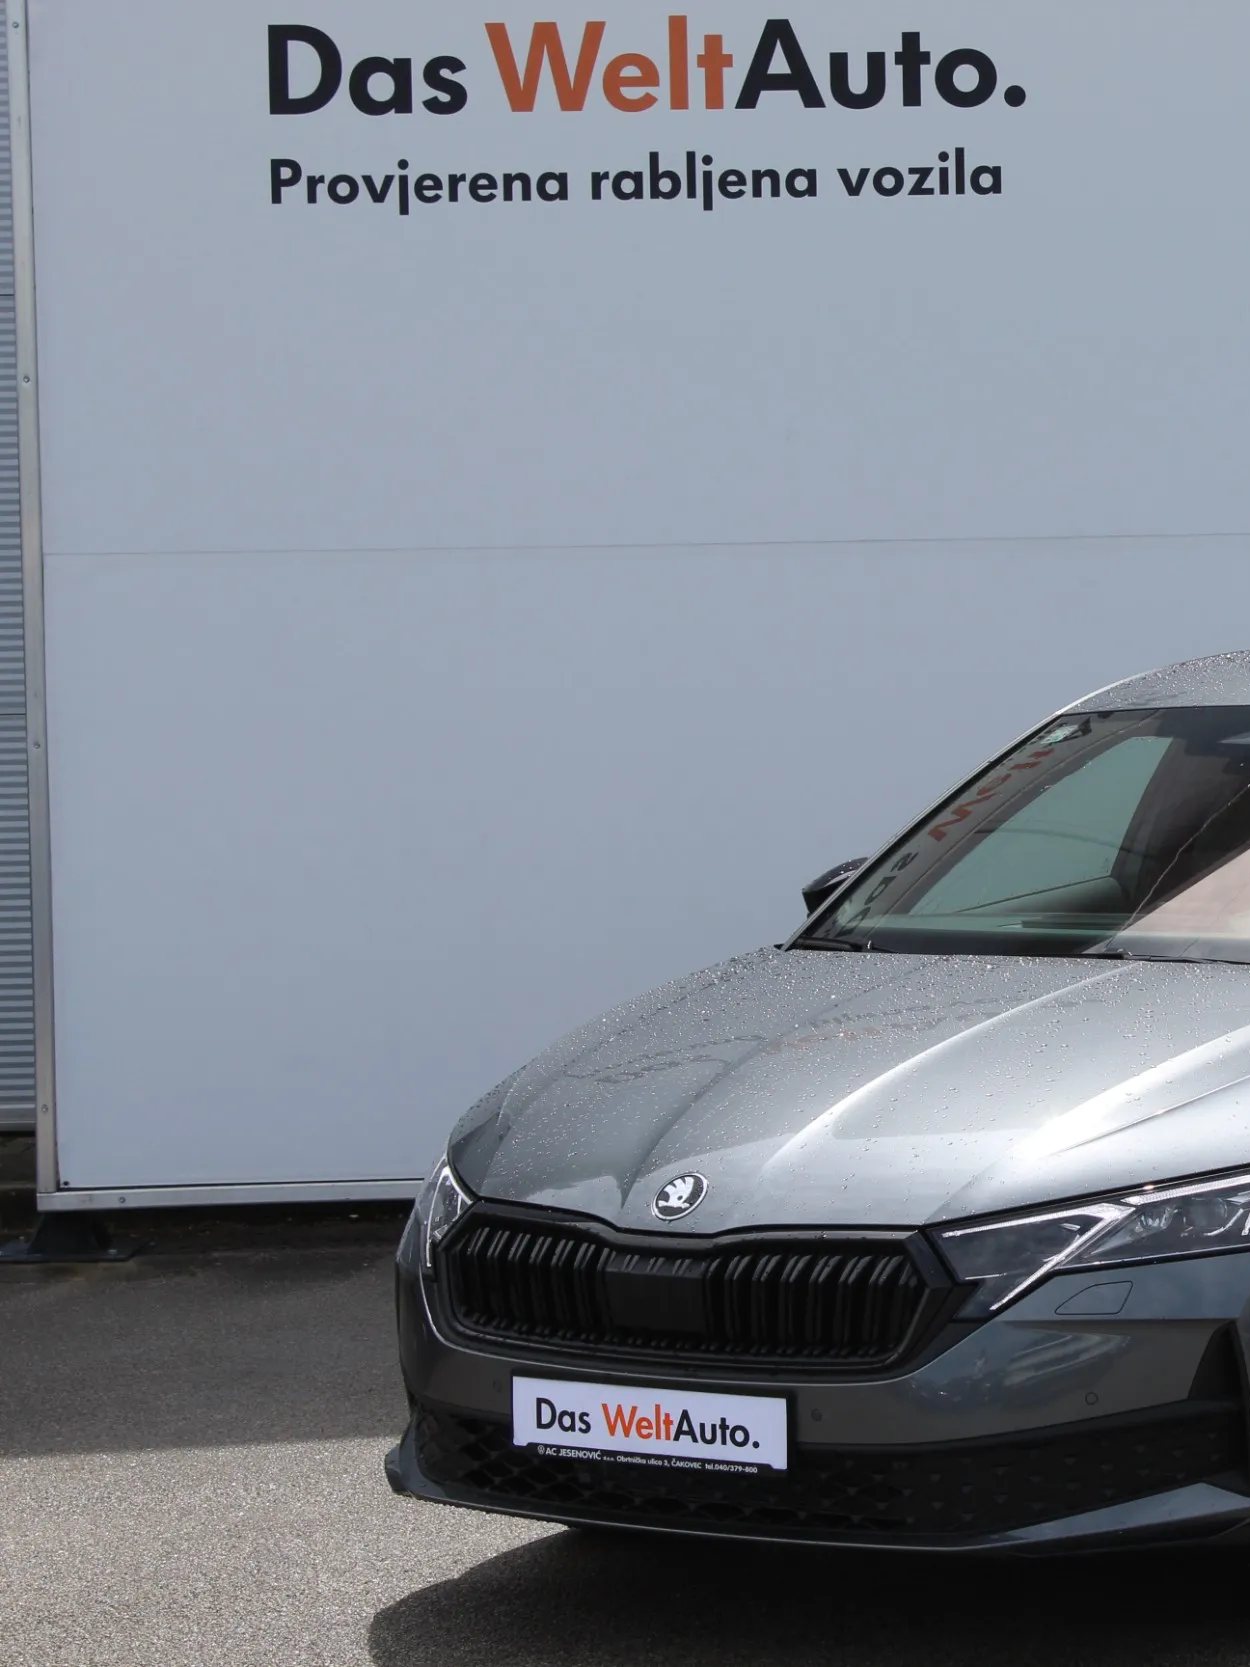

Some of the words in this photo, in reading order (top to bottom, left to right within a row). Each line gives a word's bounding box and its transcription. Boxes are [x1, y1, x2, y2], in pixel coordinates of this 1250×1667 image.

[269, 24, 468, 117] Das
[485, 15, 1028, 113] WeltAuto.
[270, 158, 570, 216] Provjerena
[590, 152, 819, 212] rabljena
[837, 147, 1003, 198] vozila
[535, 1397, 592, 1434] Das
[601, 1403, 760, 1449] WeltAuto.
[545, 1447, 557, 1456] AC
[558, 1448, 602, 1460] JESENOVIĆ
[671, 1457, 702, 1470] ČAKOVEC
